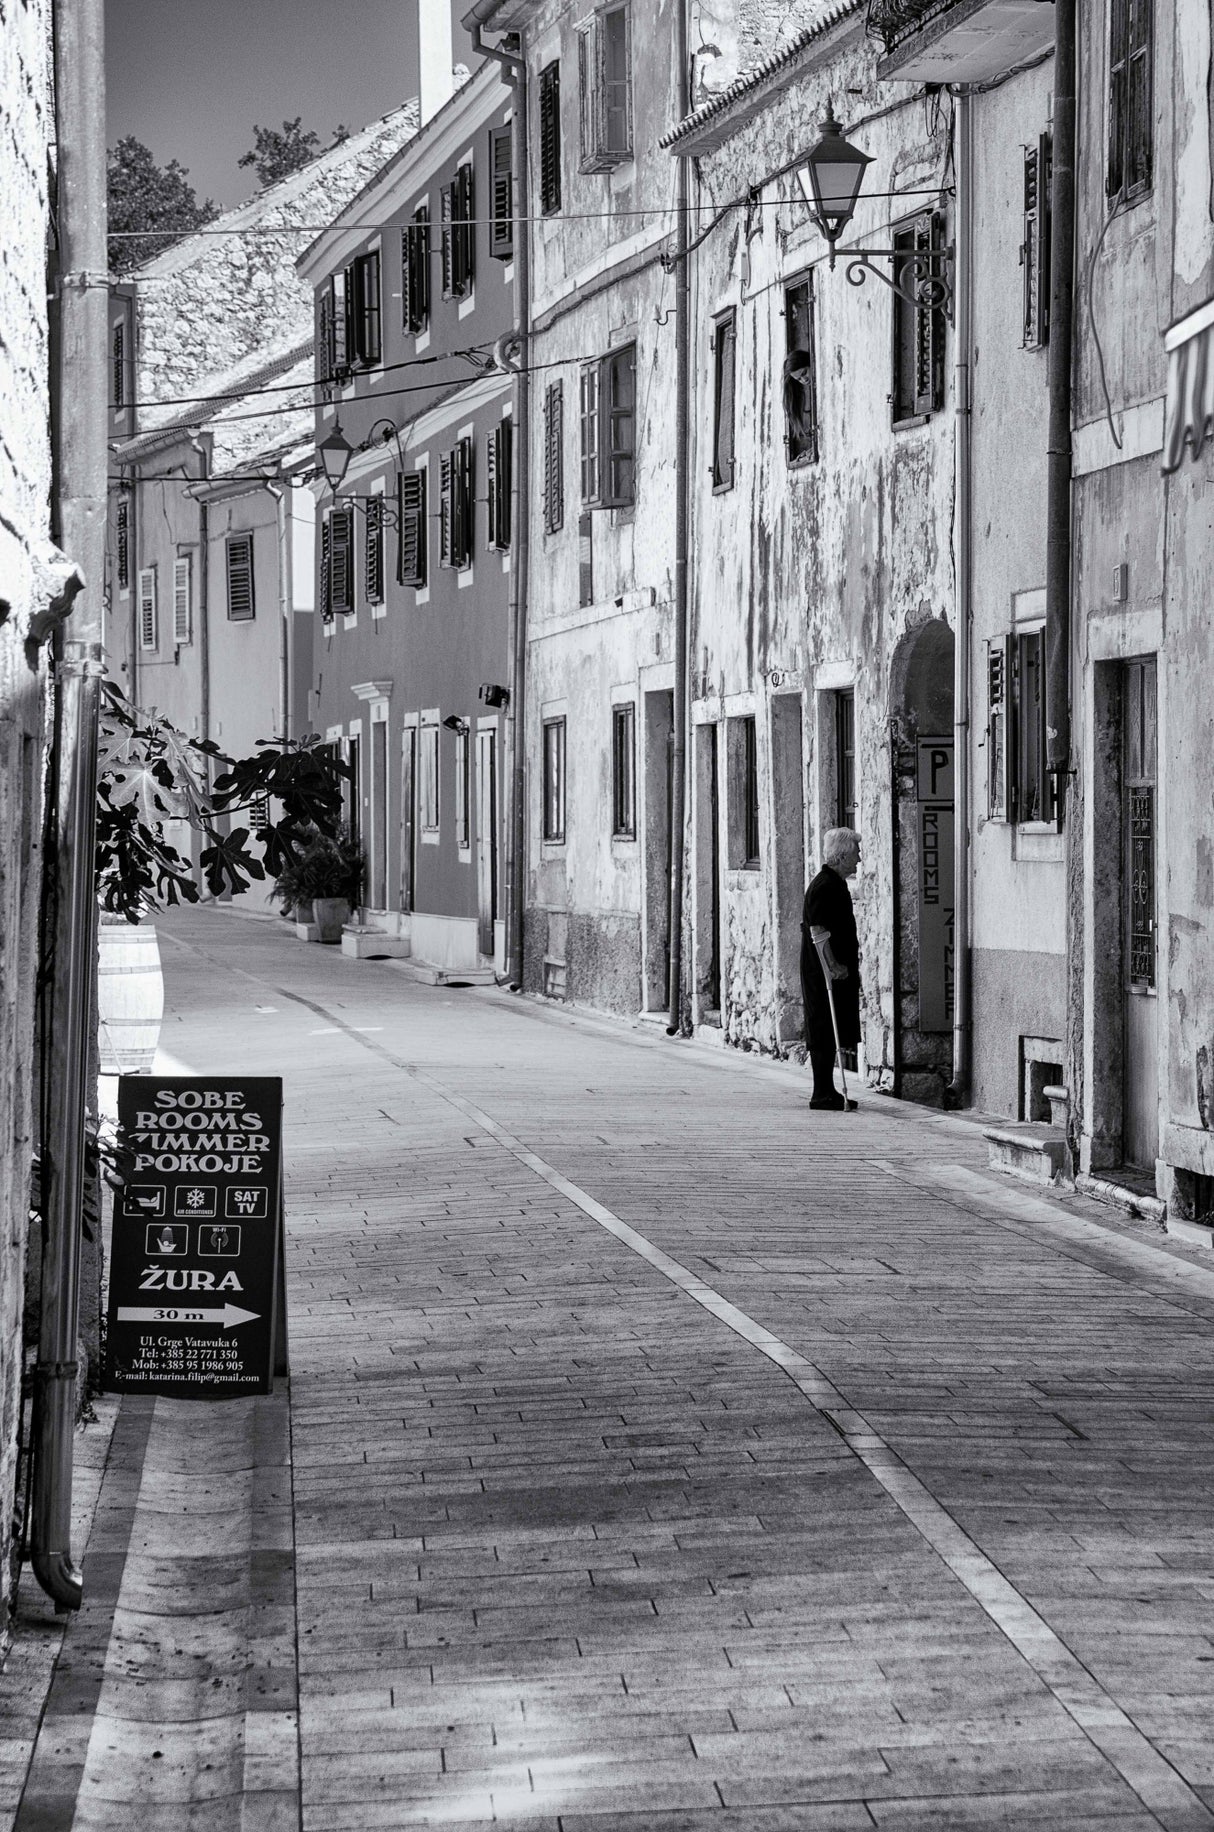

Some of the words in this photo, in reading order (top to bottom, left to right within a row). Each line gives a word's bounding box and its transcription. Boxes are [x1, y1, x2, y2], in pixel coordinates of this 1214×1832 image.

[931, 750, 949, 795] P
[922, 812, 939, 905] ROOMS
[153, 1090, 247, 1110] SOBE
[135, 1111, 263, 1131] ROOMS
[133, 1153, 263, 1174] POKOJE
[234, 1191, 261, 1202] SAT
[237, 1203, 256, 1214] TV
[138, 1264, 244, 1291] ŽURA
[153, 1309, 179, 1320] 30
[184, 1312, 204, 1320] m
[140, 1336, 155, 1346] Ul.
[158, 1336, 183, 1349] Grge
[185, 1337, 230, 1347] Vatavuka
[231, 1337, 238, 1347] 6
[139, 1348, 159, 1359] Tel:
[161, 1350, 184, 1359] +385
[186, 1350, 198, 1359] 22
[200, 1350, 217, 1359] 771
[219, 1350, 238, 1360] 350
[132, 1359, 159, 1369] Mob:
[161, 1360, 184, 1369] +385
[186, 1360, 198, 1370] 95
[201, 1360, 224, 1370] 1986
[226, 1360, 244, 1371] 905
[115, 1370, 148, 1380] E-mail:
[149, 1371, 260, 1384] katarina.filip@gmail.com
